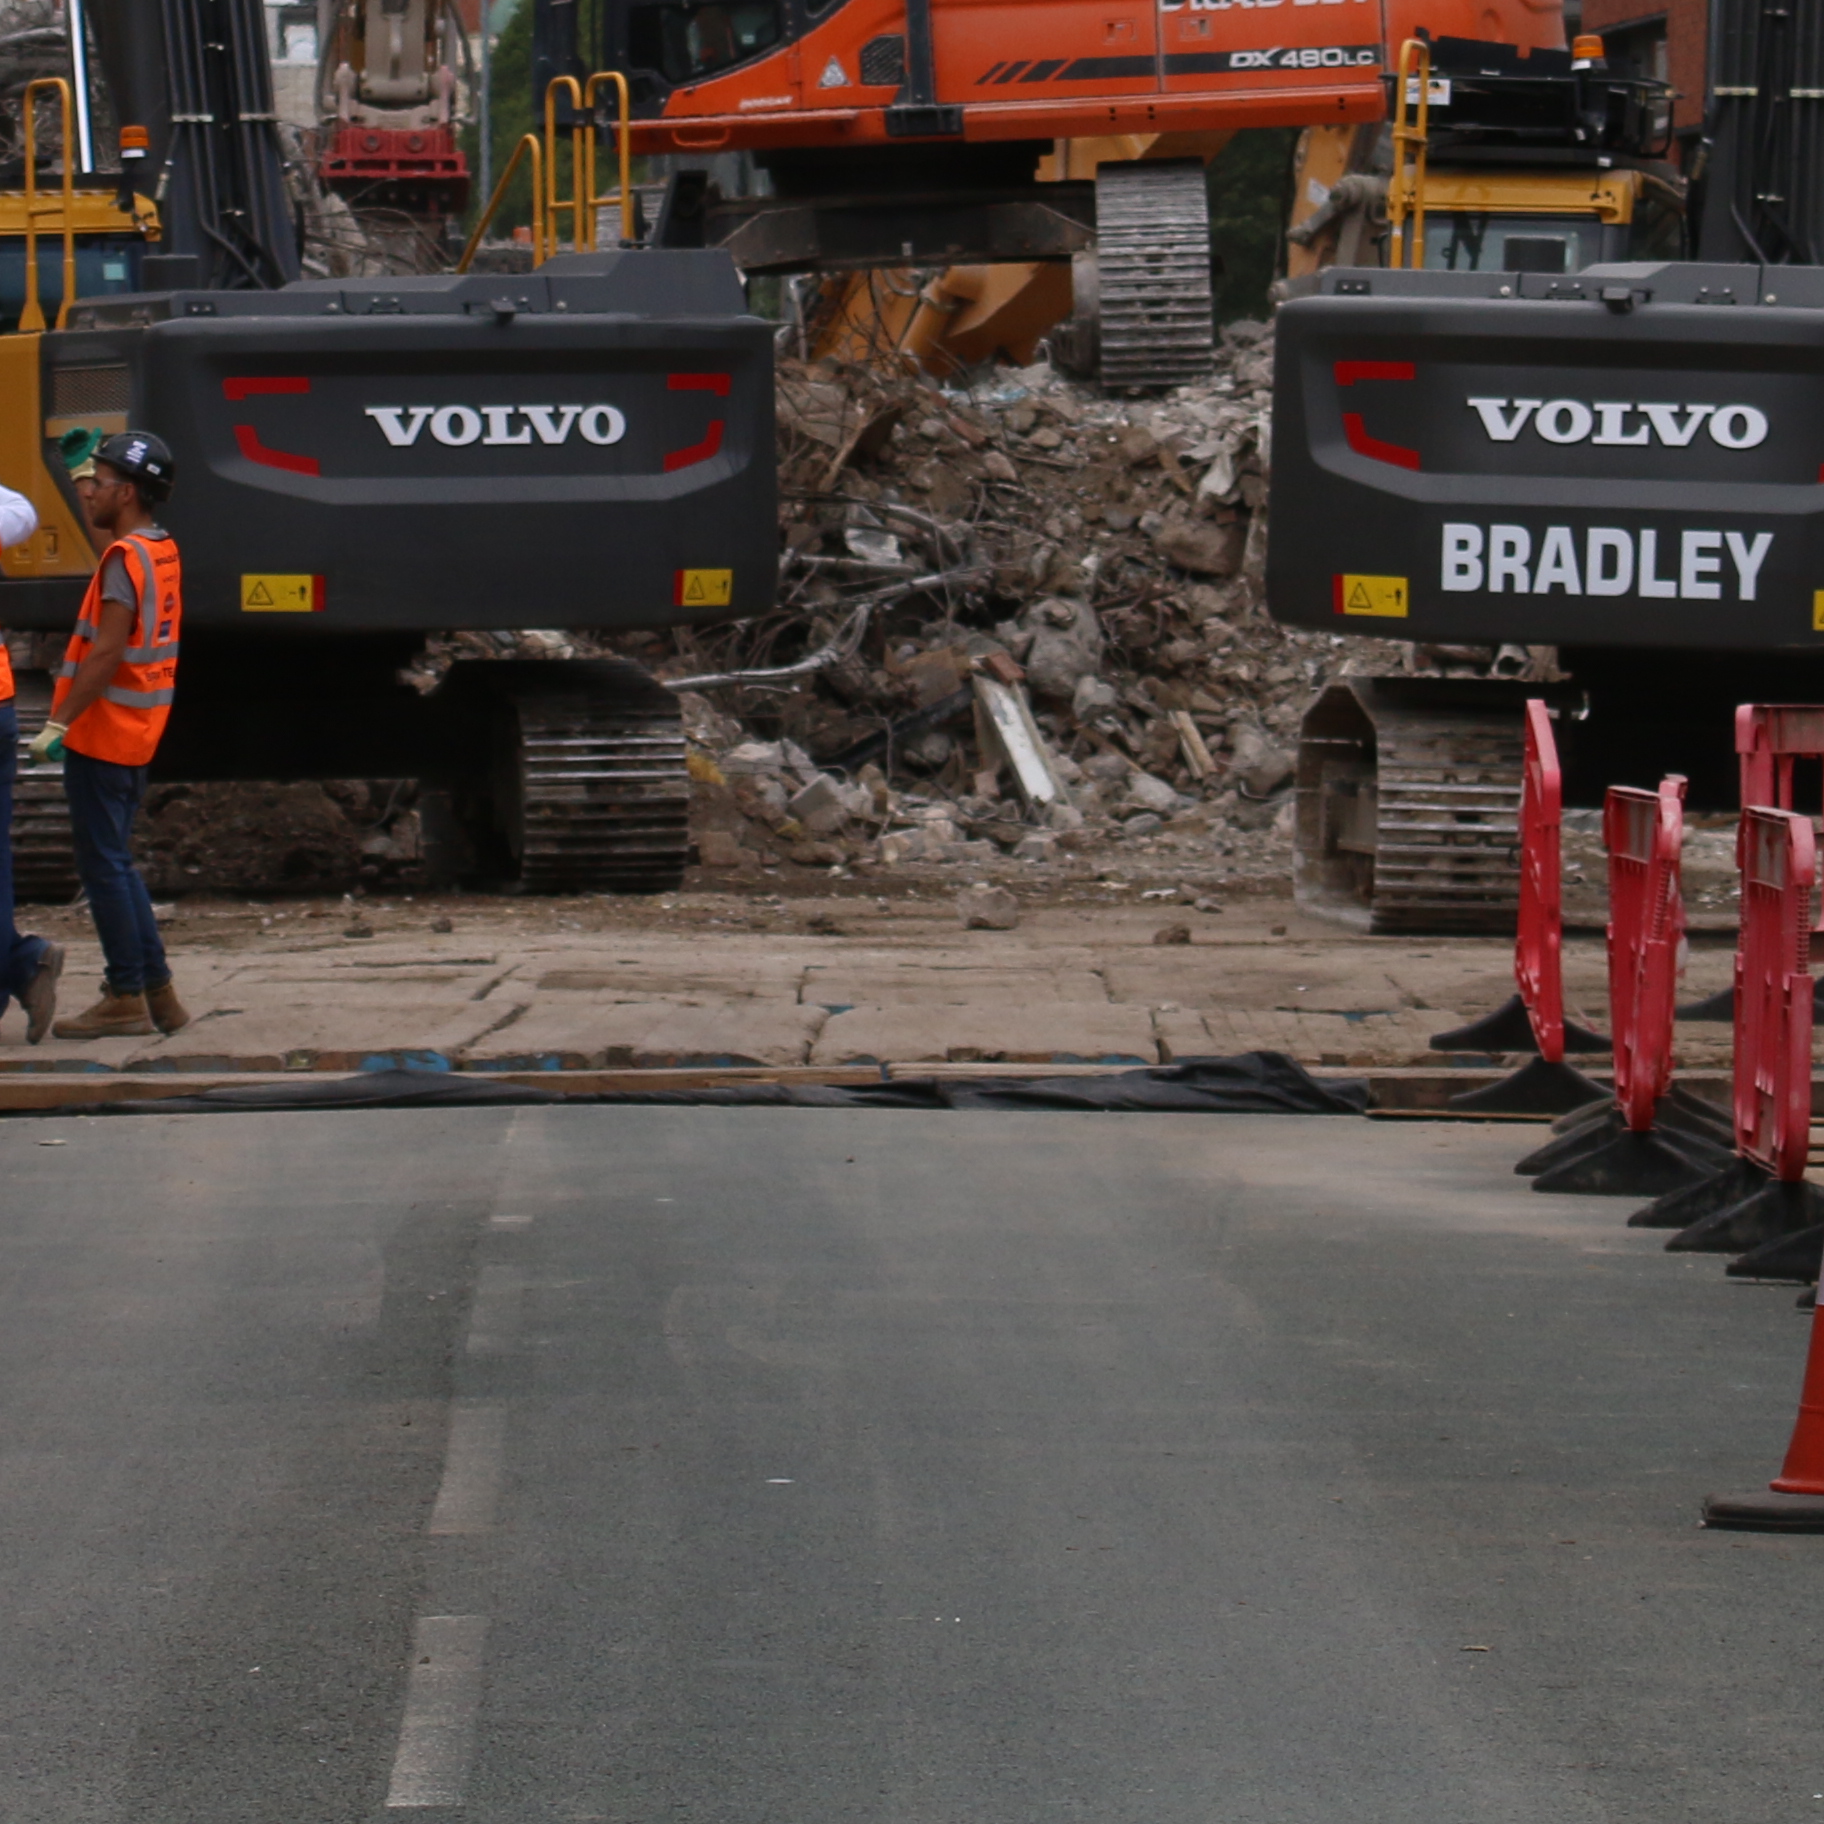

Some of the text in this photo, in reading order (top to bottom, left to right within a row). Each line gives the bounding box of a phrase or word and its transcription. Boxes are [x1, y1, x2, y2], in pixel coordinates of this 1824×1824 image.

[364, 403, 627, 449] VOLVO
[1467, 396, 1769, 451] VOLVO
[1440, 522, 1775, 602] BRADLEY
